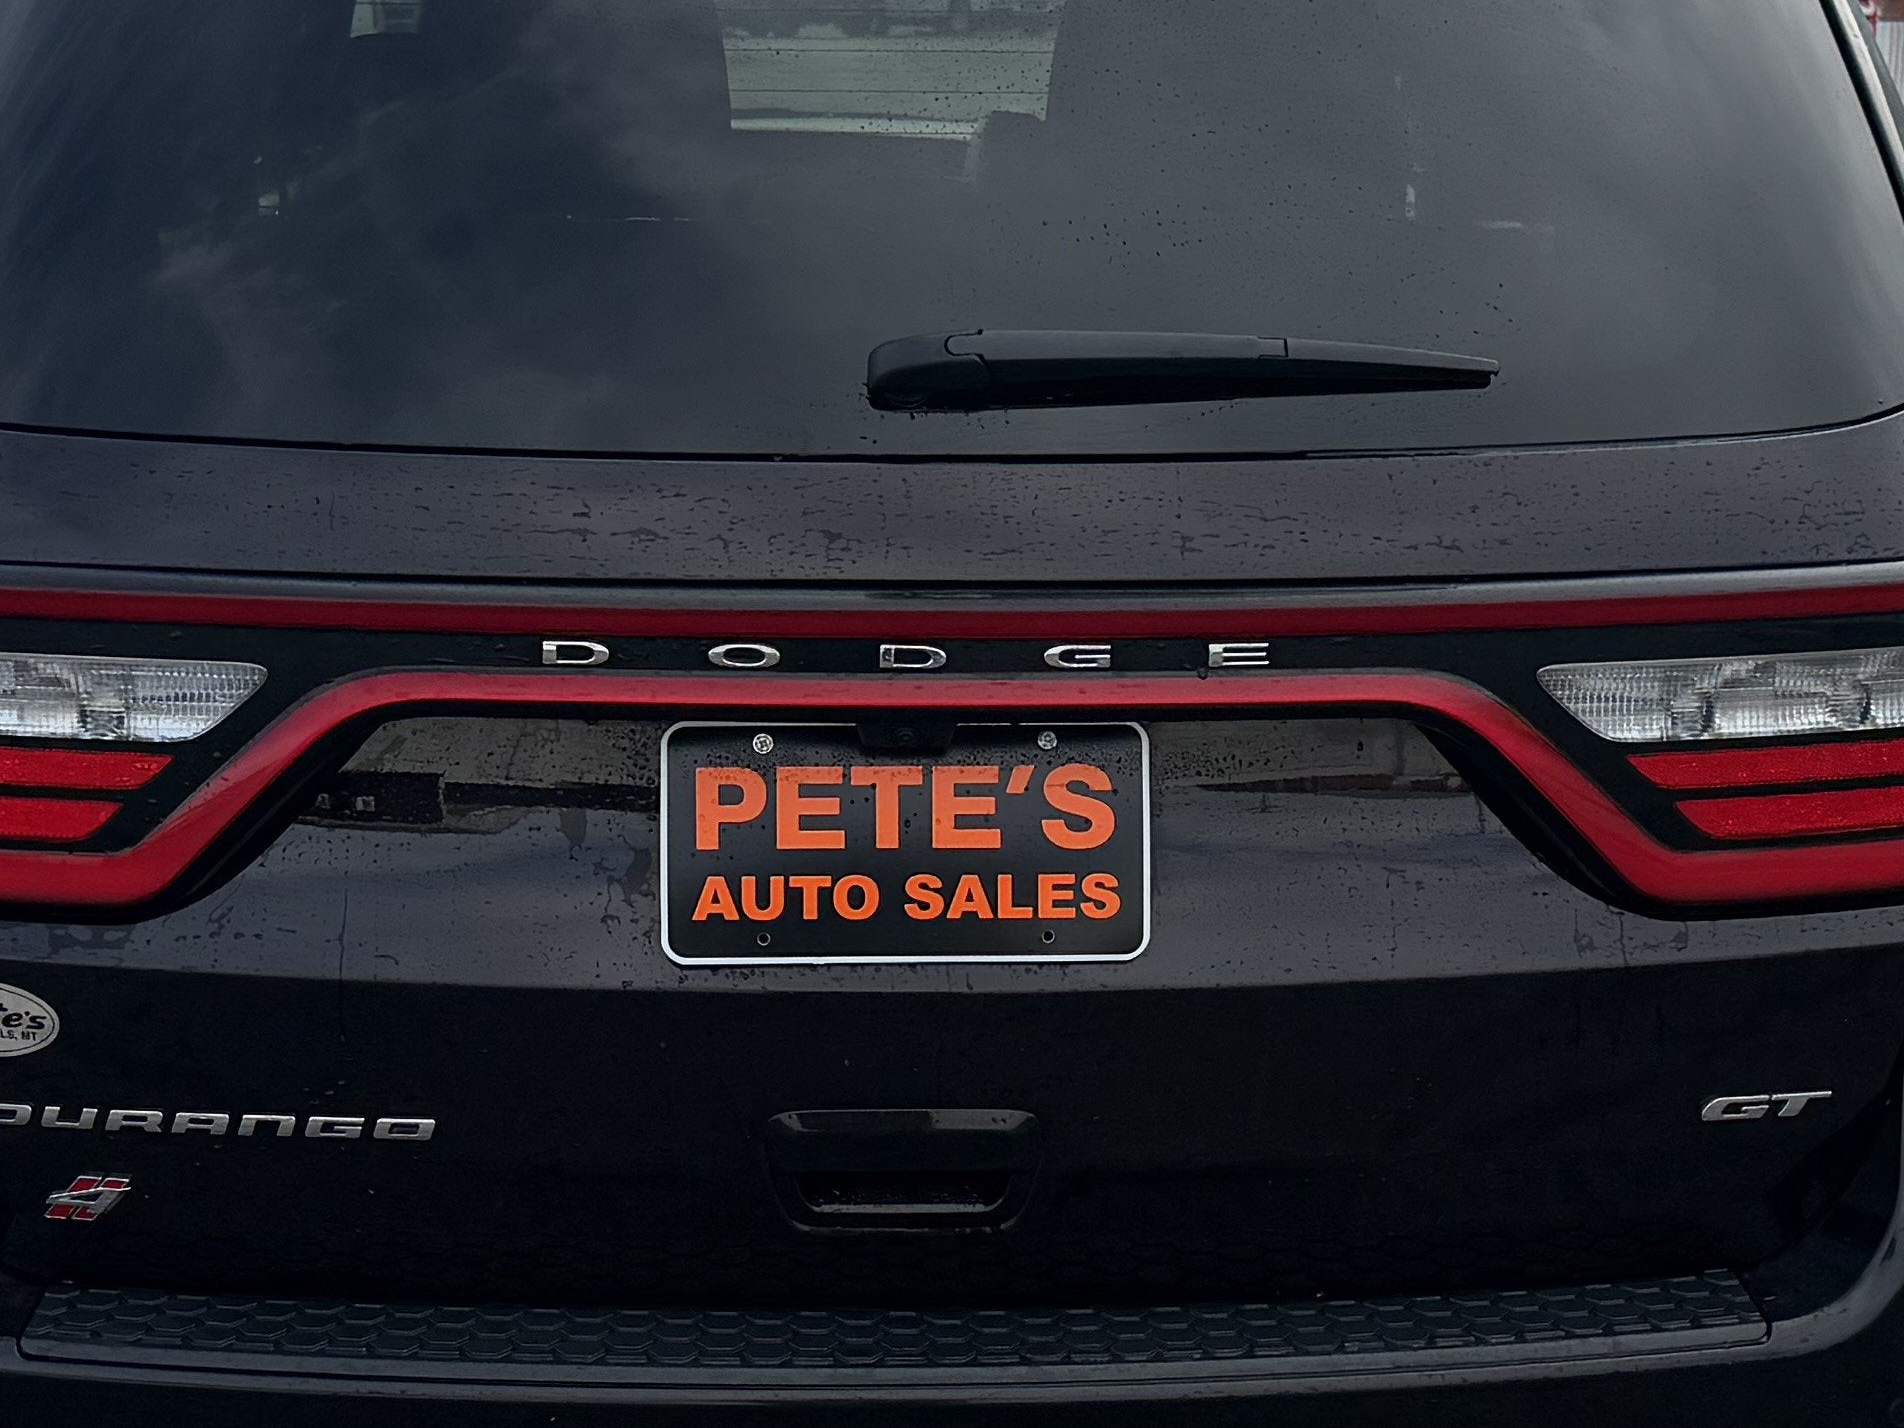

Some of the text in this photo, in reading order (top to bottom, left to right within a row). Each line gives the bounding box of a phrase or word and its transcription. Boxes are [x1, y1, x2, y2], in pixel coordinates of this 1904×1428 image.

[542, 640, 1271, 669] DODGE
[695, 764, 1116, 852] PETE'S
[692, 873, 1122, 922] AUTO SALES
[21, 1031, 38, 1041] MT
[1701, 1090, 1832, 1122] GT
